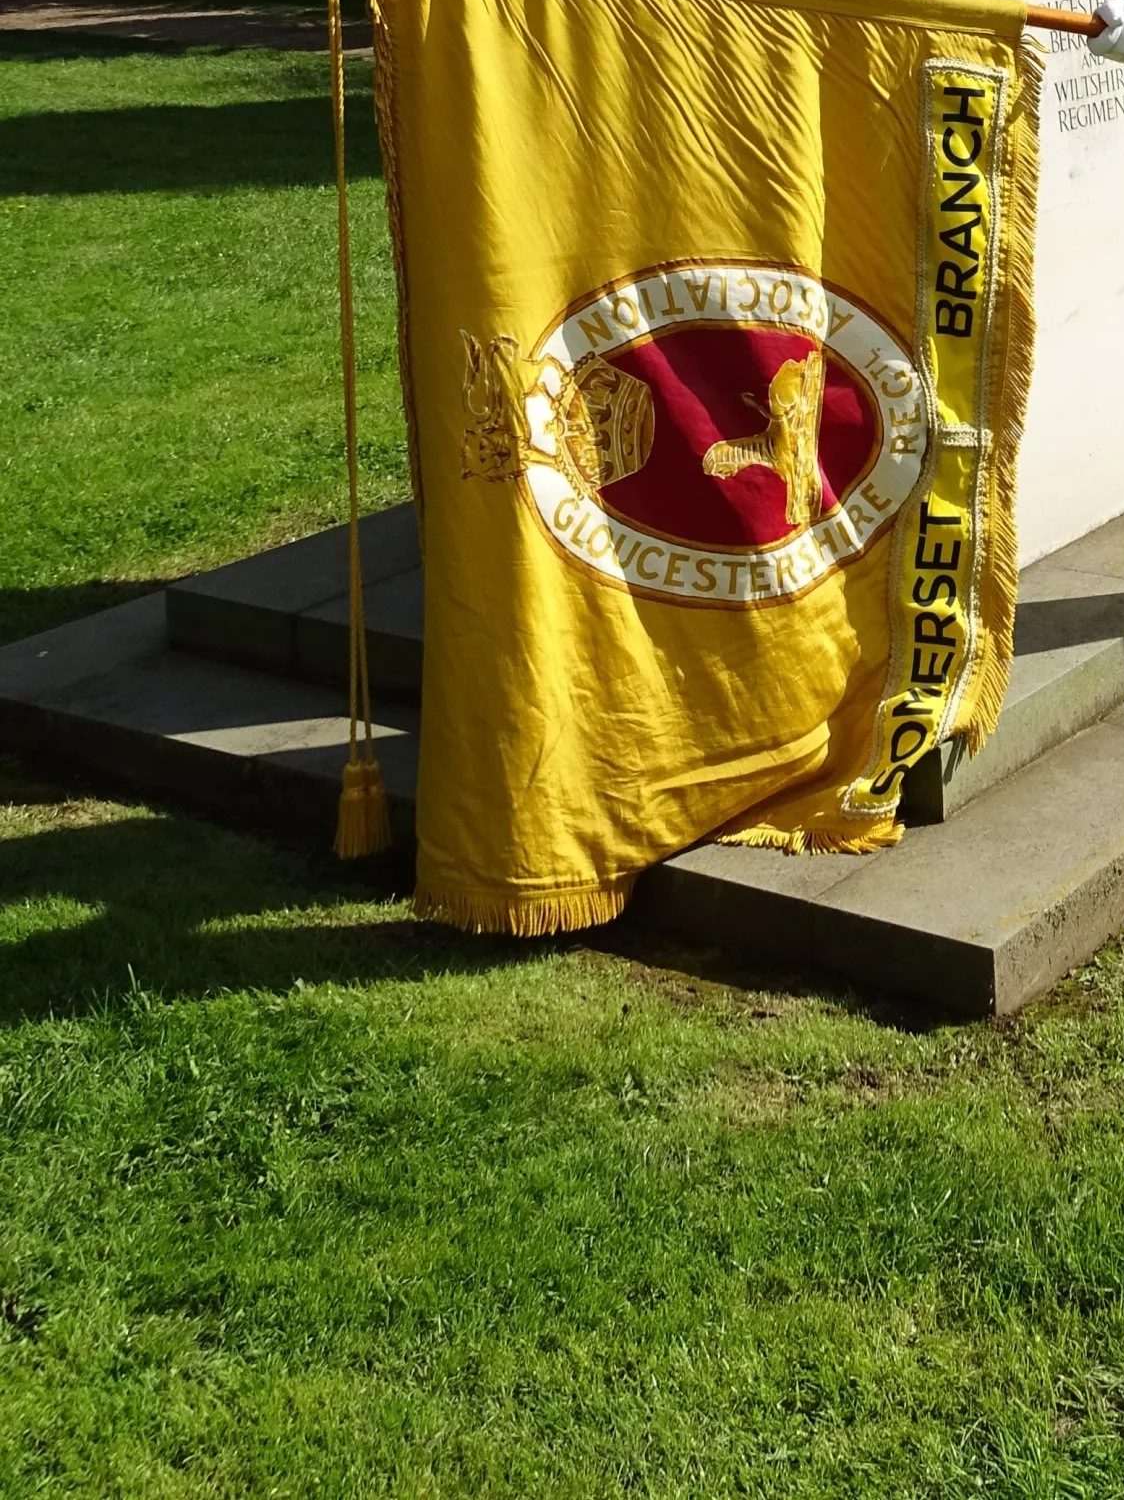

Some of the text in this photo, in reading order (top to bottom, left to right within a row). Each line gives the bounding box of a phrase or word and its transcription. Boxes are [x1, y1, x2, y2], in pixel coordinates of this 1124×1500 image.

[1082, 52, 1105, 70] AND
[577, 275, 855, 349] ASSOCIATION
[870, 86, 986, 796] SOMERSET BRANCH
[552, 482, 891, 595] GLOUCESTERSHIRE
